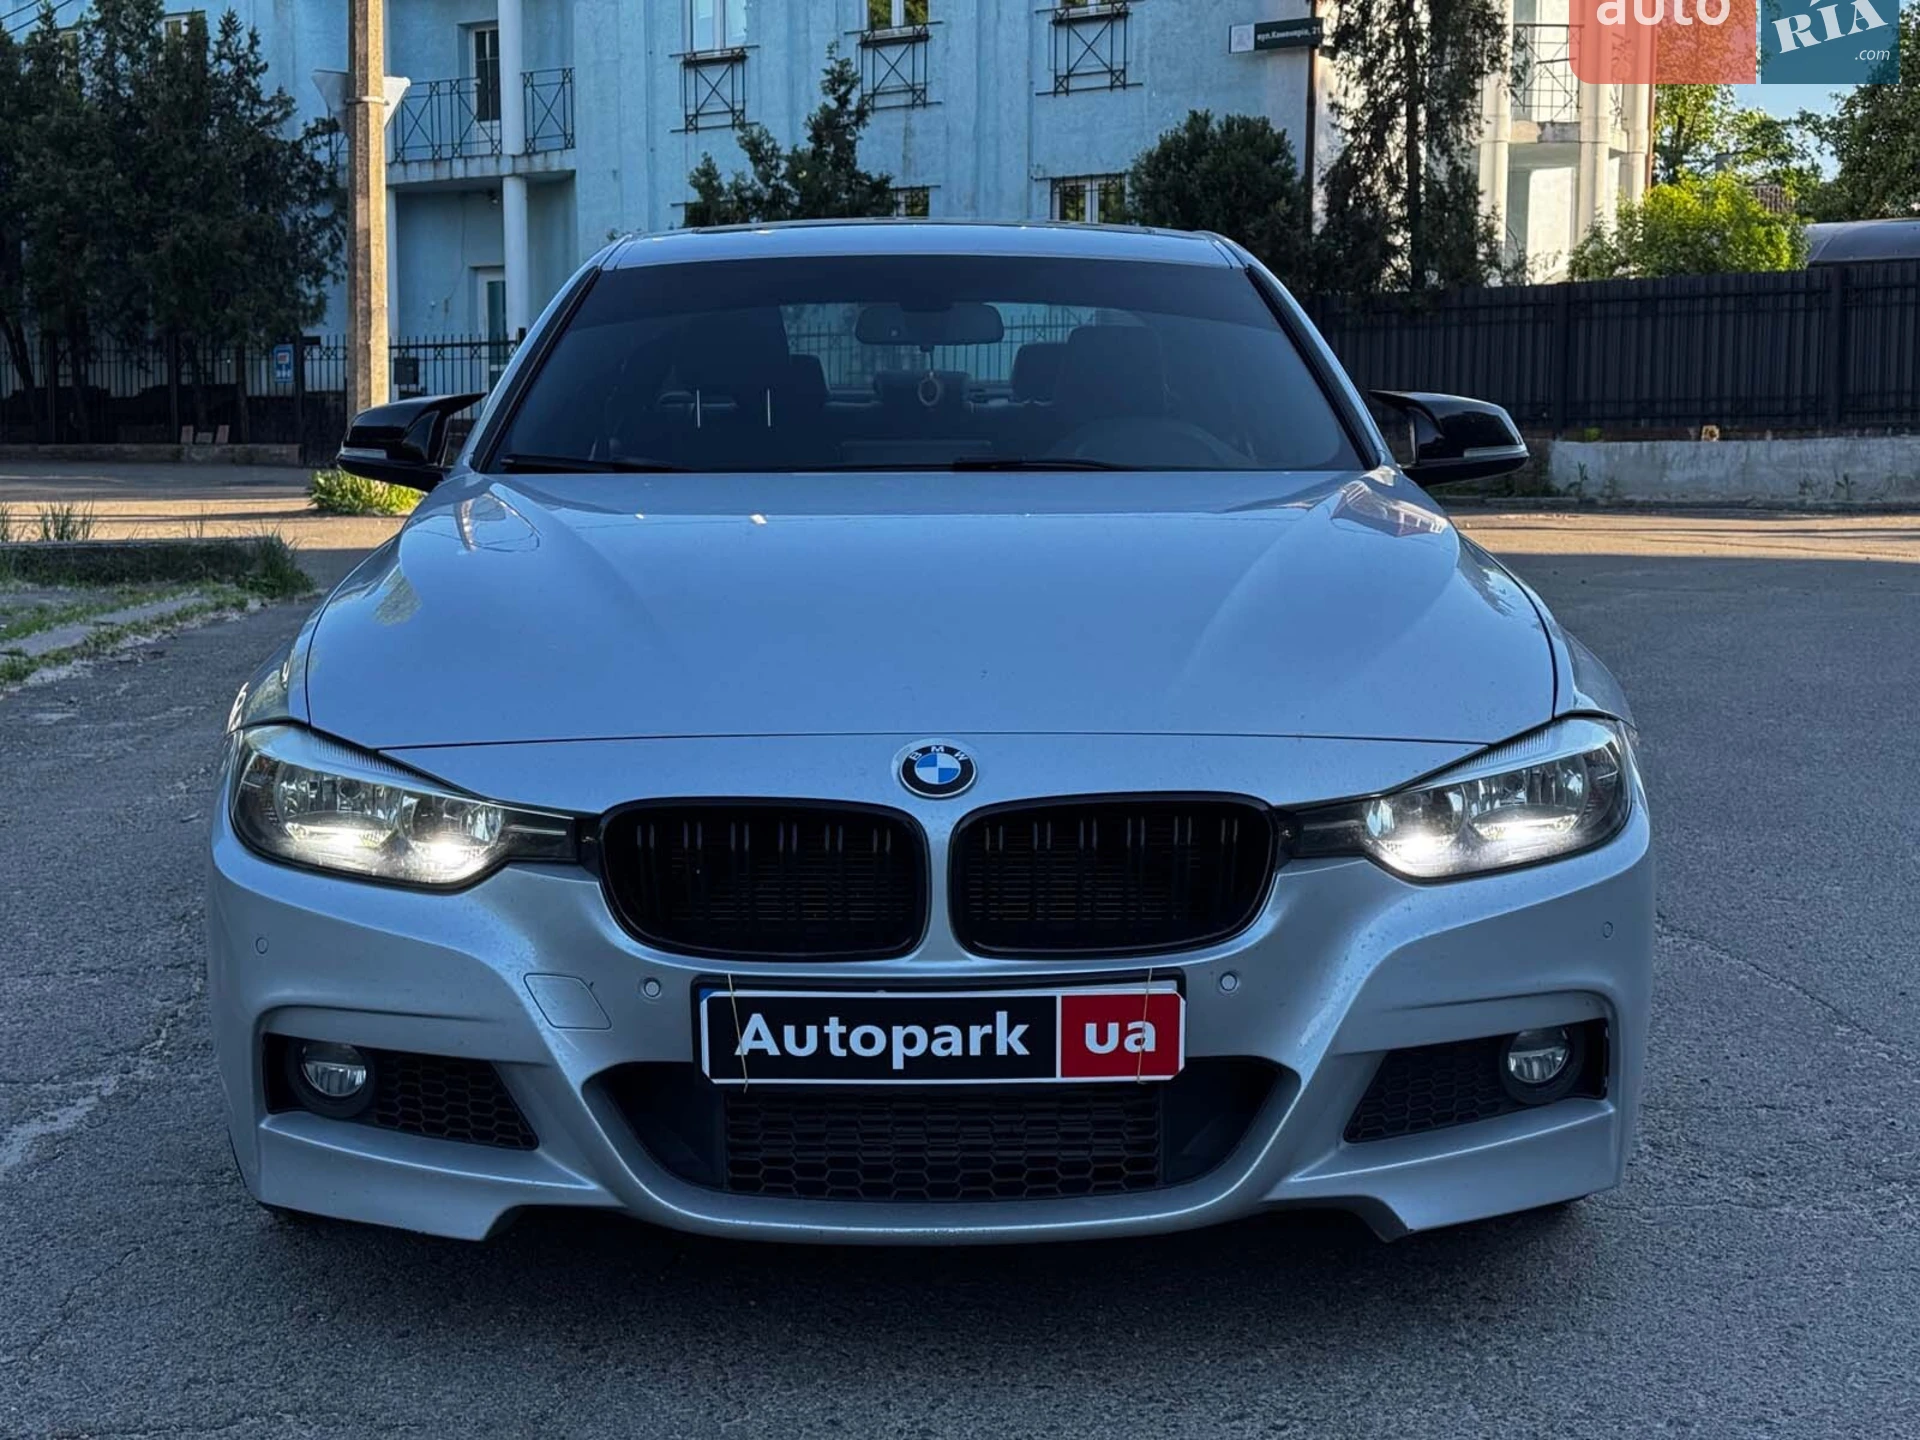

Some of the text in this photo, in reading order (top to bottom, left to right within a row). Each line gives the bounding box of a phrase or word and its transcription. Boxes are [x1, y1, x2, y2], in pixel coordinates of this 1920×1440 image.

[909, 745, 969, 761] BMW
[734, 1011, 1157, 1070] Autopark ua
